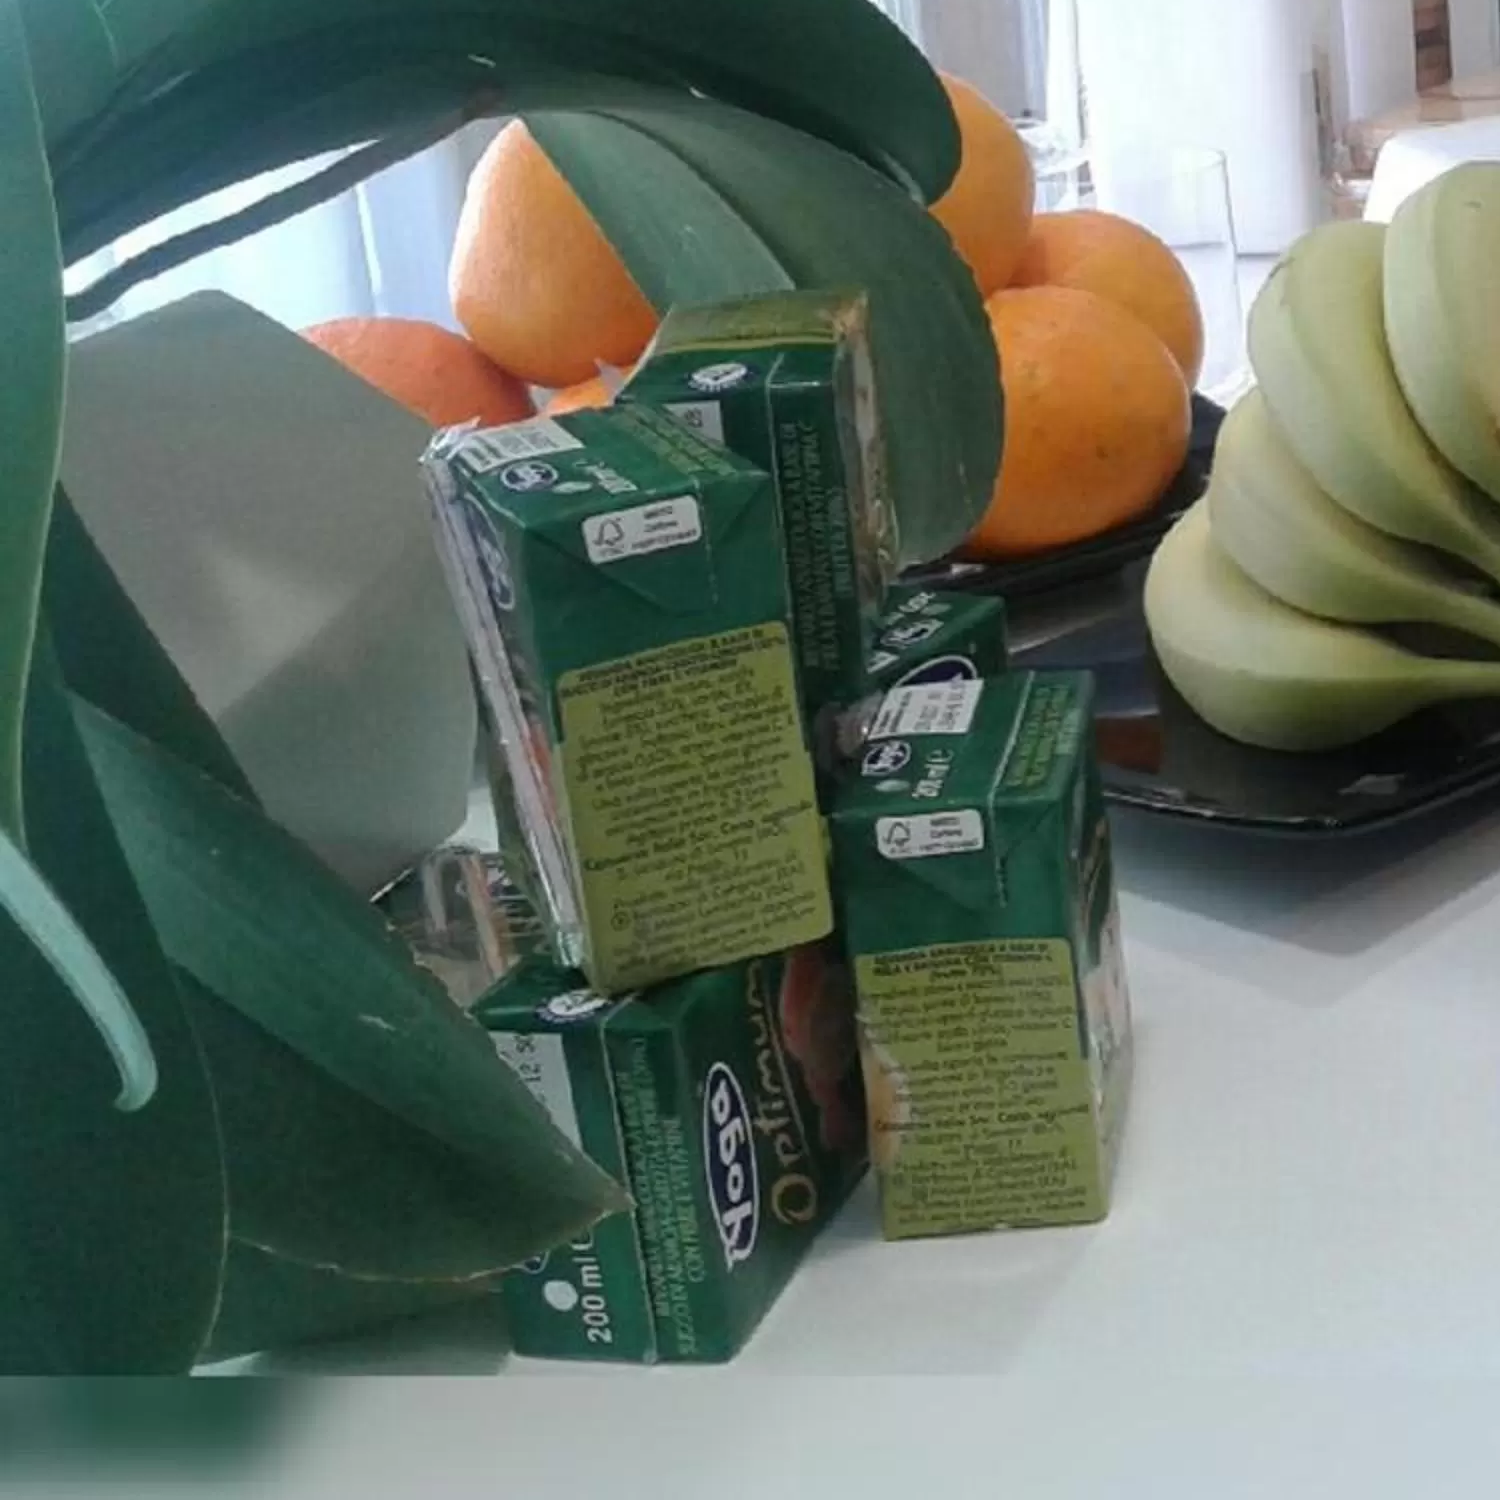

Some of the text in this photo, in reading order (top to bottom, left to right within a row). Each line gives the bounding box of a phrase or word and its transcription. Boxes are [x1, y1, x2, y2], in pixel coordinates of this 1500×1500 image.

[711, 1078, 755, 1253] Yoga
[745, 961, 818, 1225] Optimum
[571, 1256, 614, 1345] 200 ml
